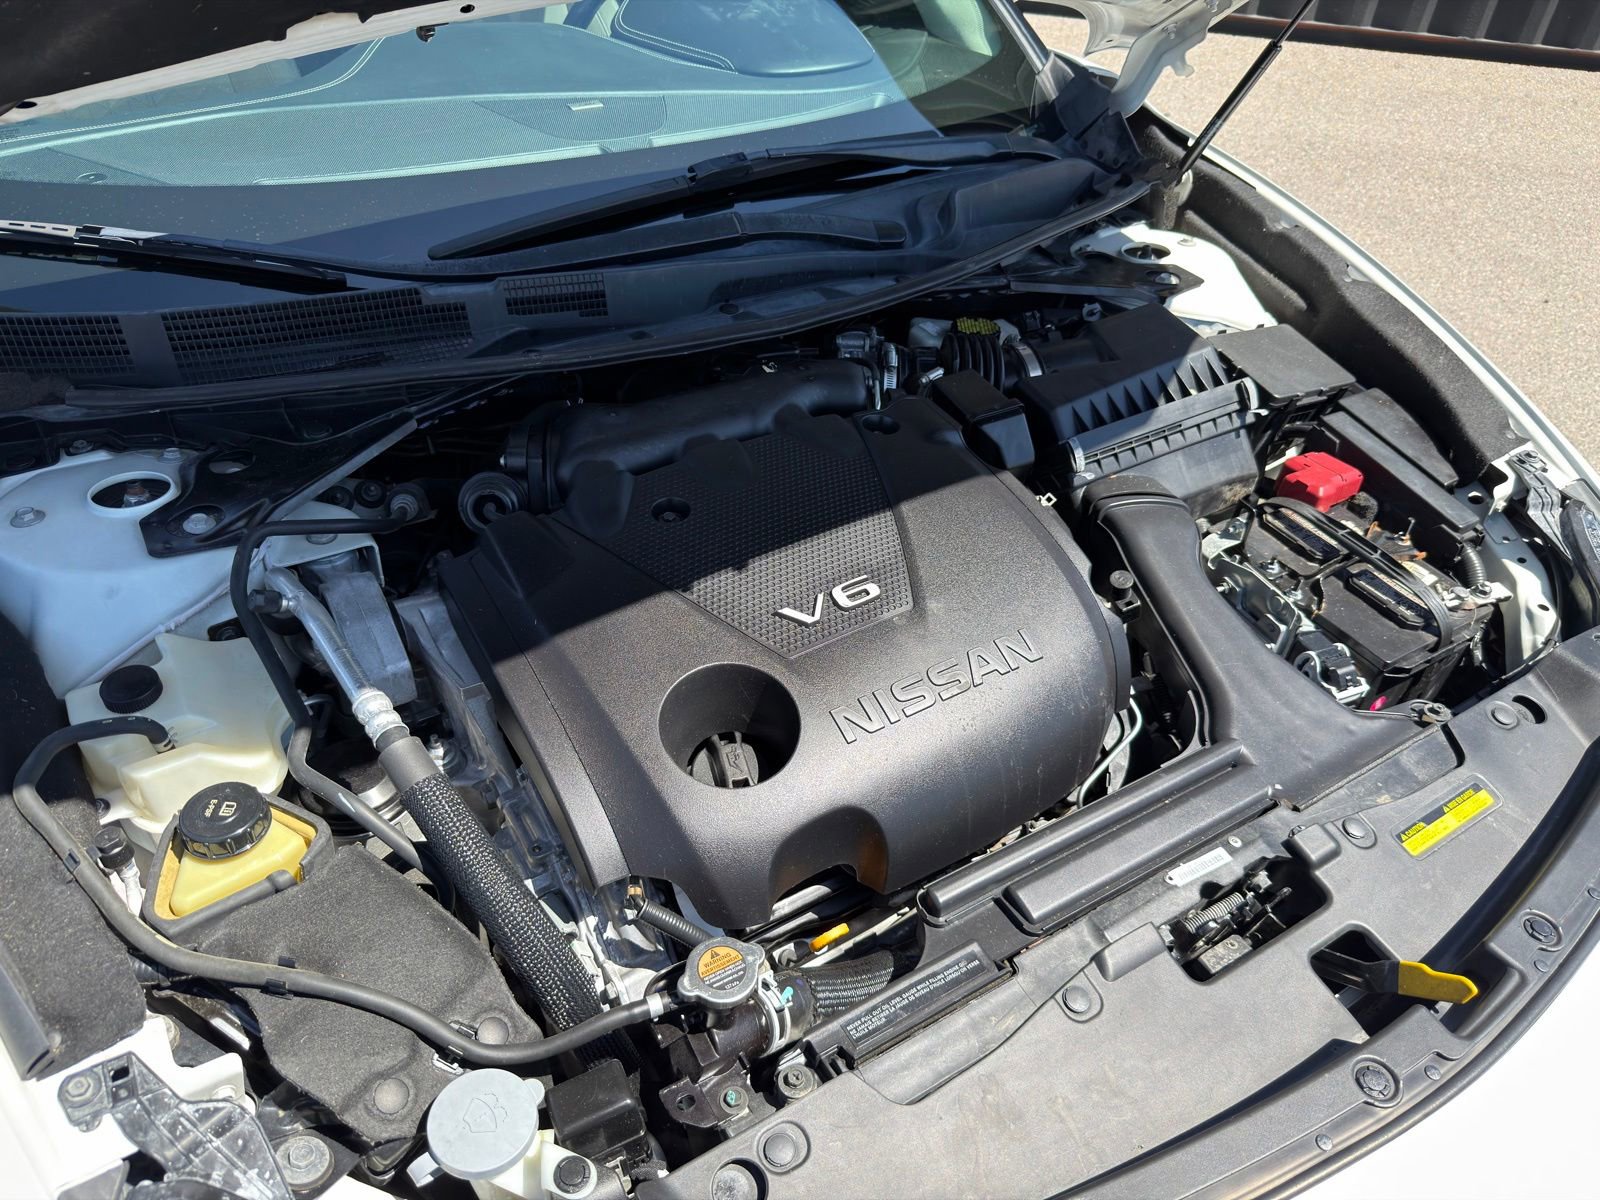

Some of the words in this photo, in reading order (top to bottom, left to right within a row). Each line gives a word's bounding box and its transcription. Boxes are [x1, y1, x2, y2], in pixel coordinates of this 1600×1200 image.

[771, 574, 881, 629] V6
[830, 629, 1043, 744] NISSAN
[701, 955, 740, 975] AVERTISSEMENT
[704, 953, 731, 968] WARNING
[847, 1020, 862, 1031] NEVER
[861, 1014, 873, 1023] PULL
[872, 1008, 882, 1016] OUT
[889, 996, 903, 1006] LEVEL
[902, 987, 917, 999] GAUGE
[917, 980, 930, 991] WHILE
[929, 972, 945, 984] FILLING
[944, 965, 959, 976] ENGINE
[856, 1020, 872, 1032] JAMAIS
[871, 1010, 890, 1023] RETIRER
[895, 998, 909, 1009] JAUGE
[908, 994, 916, 1002] DE
[915, 987, 930, 998] NIVEAU
[929, 979, 945, 990] D'HUILE
[944, 966, 968, 982] LORSQU'ON
[966, 959, 980, 970] VERSE
[852, 1028, 869, 1039] L'HUILE
